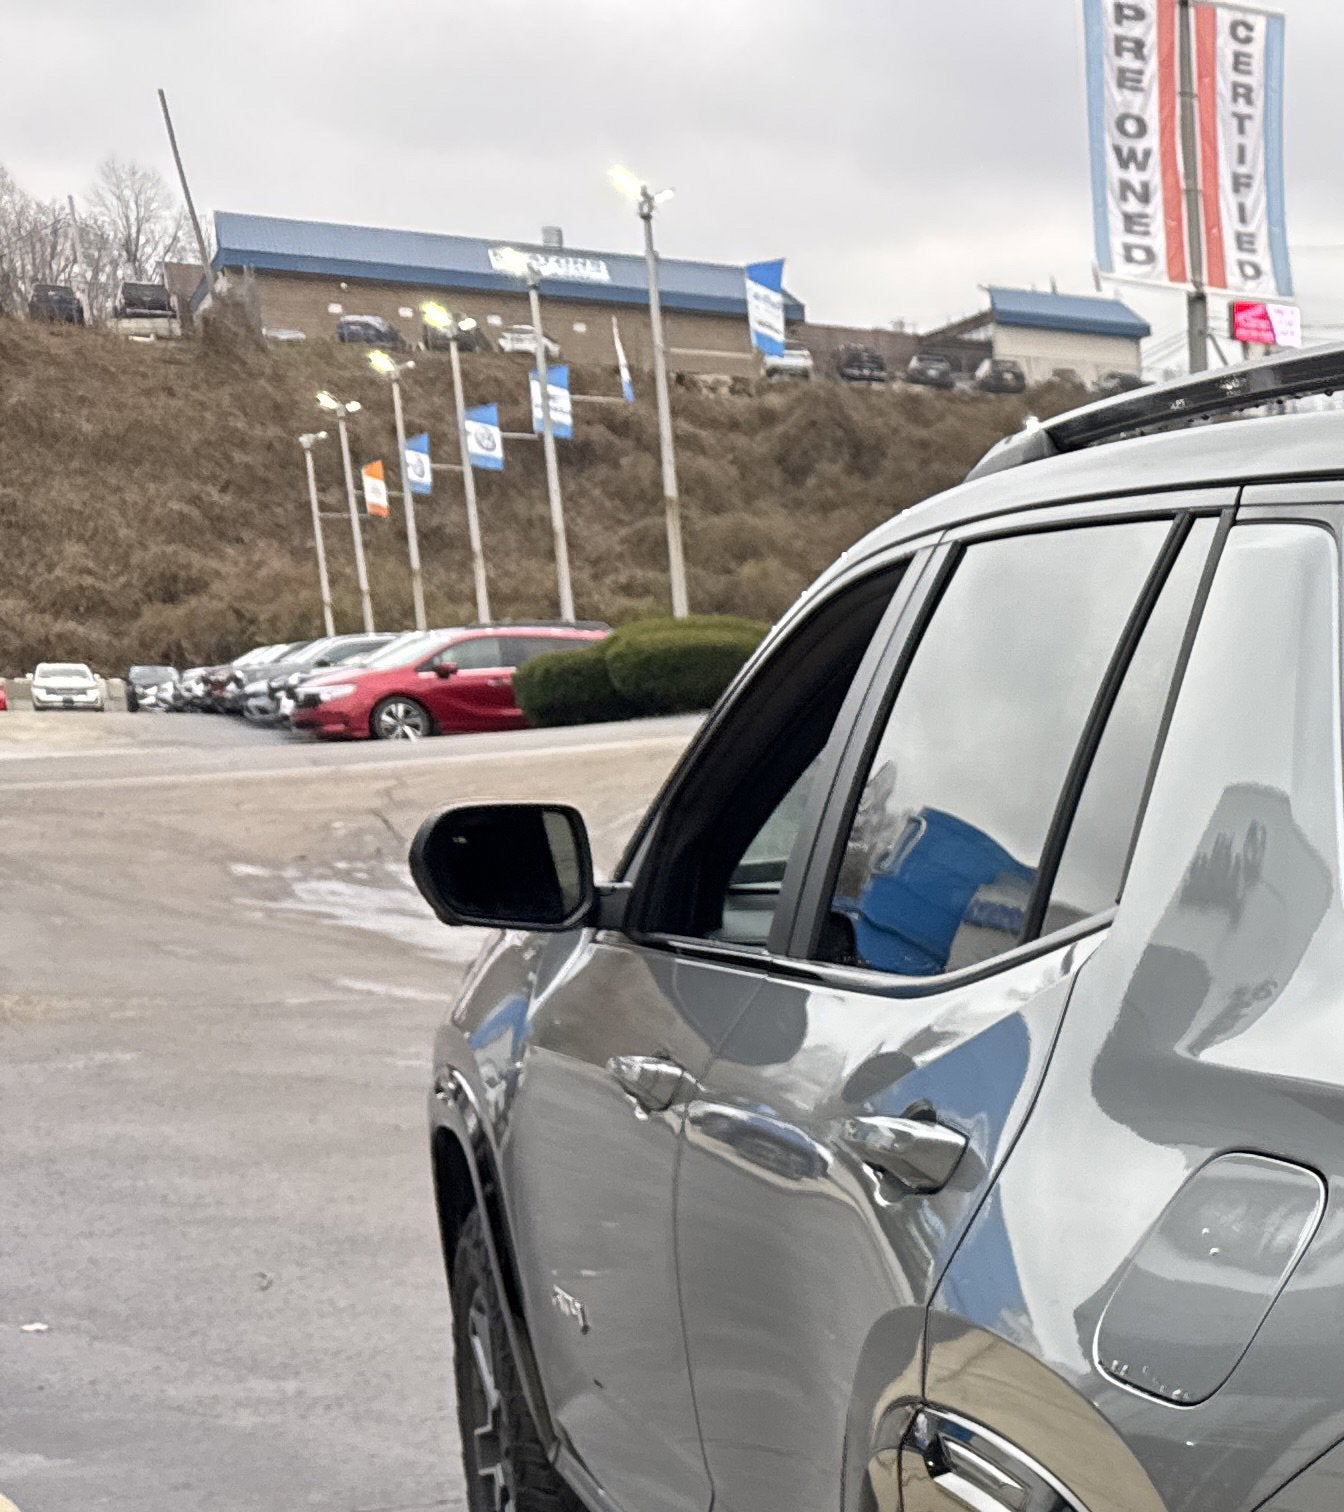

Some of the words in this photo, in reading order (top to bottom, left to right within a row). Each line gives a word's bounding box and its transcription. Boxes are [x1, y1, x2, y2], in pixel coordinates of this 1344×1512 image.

[1113, 2, 1147, 93] PRE
[1112, 112, 1156, 266] OWNED
[1229, 18, 1263, 282] CERTIFIED
